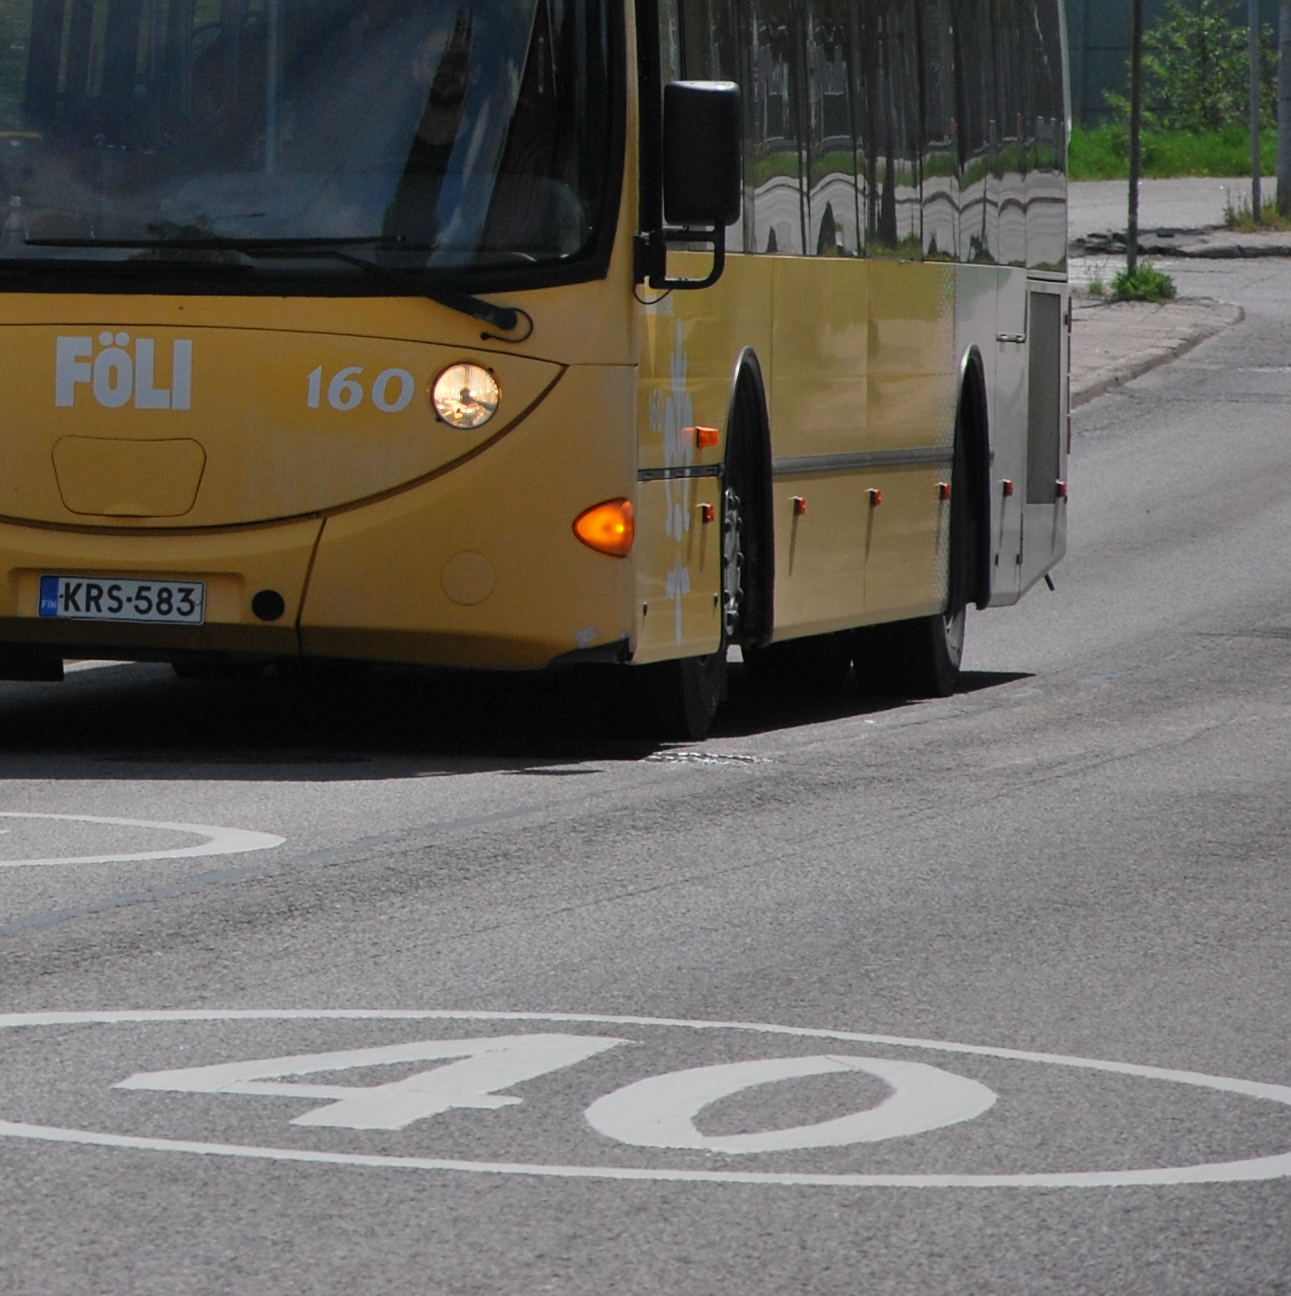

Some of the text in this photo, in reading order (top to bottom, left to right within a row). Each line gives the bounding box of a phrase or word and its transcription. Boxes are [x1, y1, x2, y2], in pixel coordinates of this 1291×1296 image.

[54, 331, 193, 410] FÖLI
[306, 365, 415, 413] 160
[41, 599, 58, 610] FIN
[63, 582, 196, 616] KRS-583
[110, 1033, 998, 1155] 40
